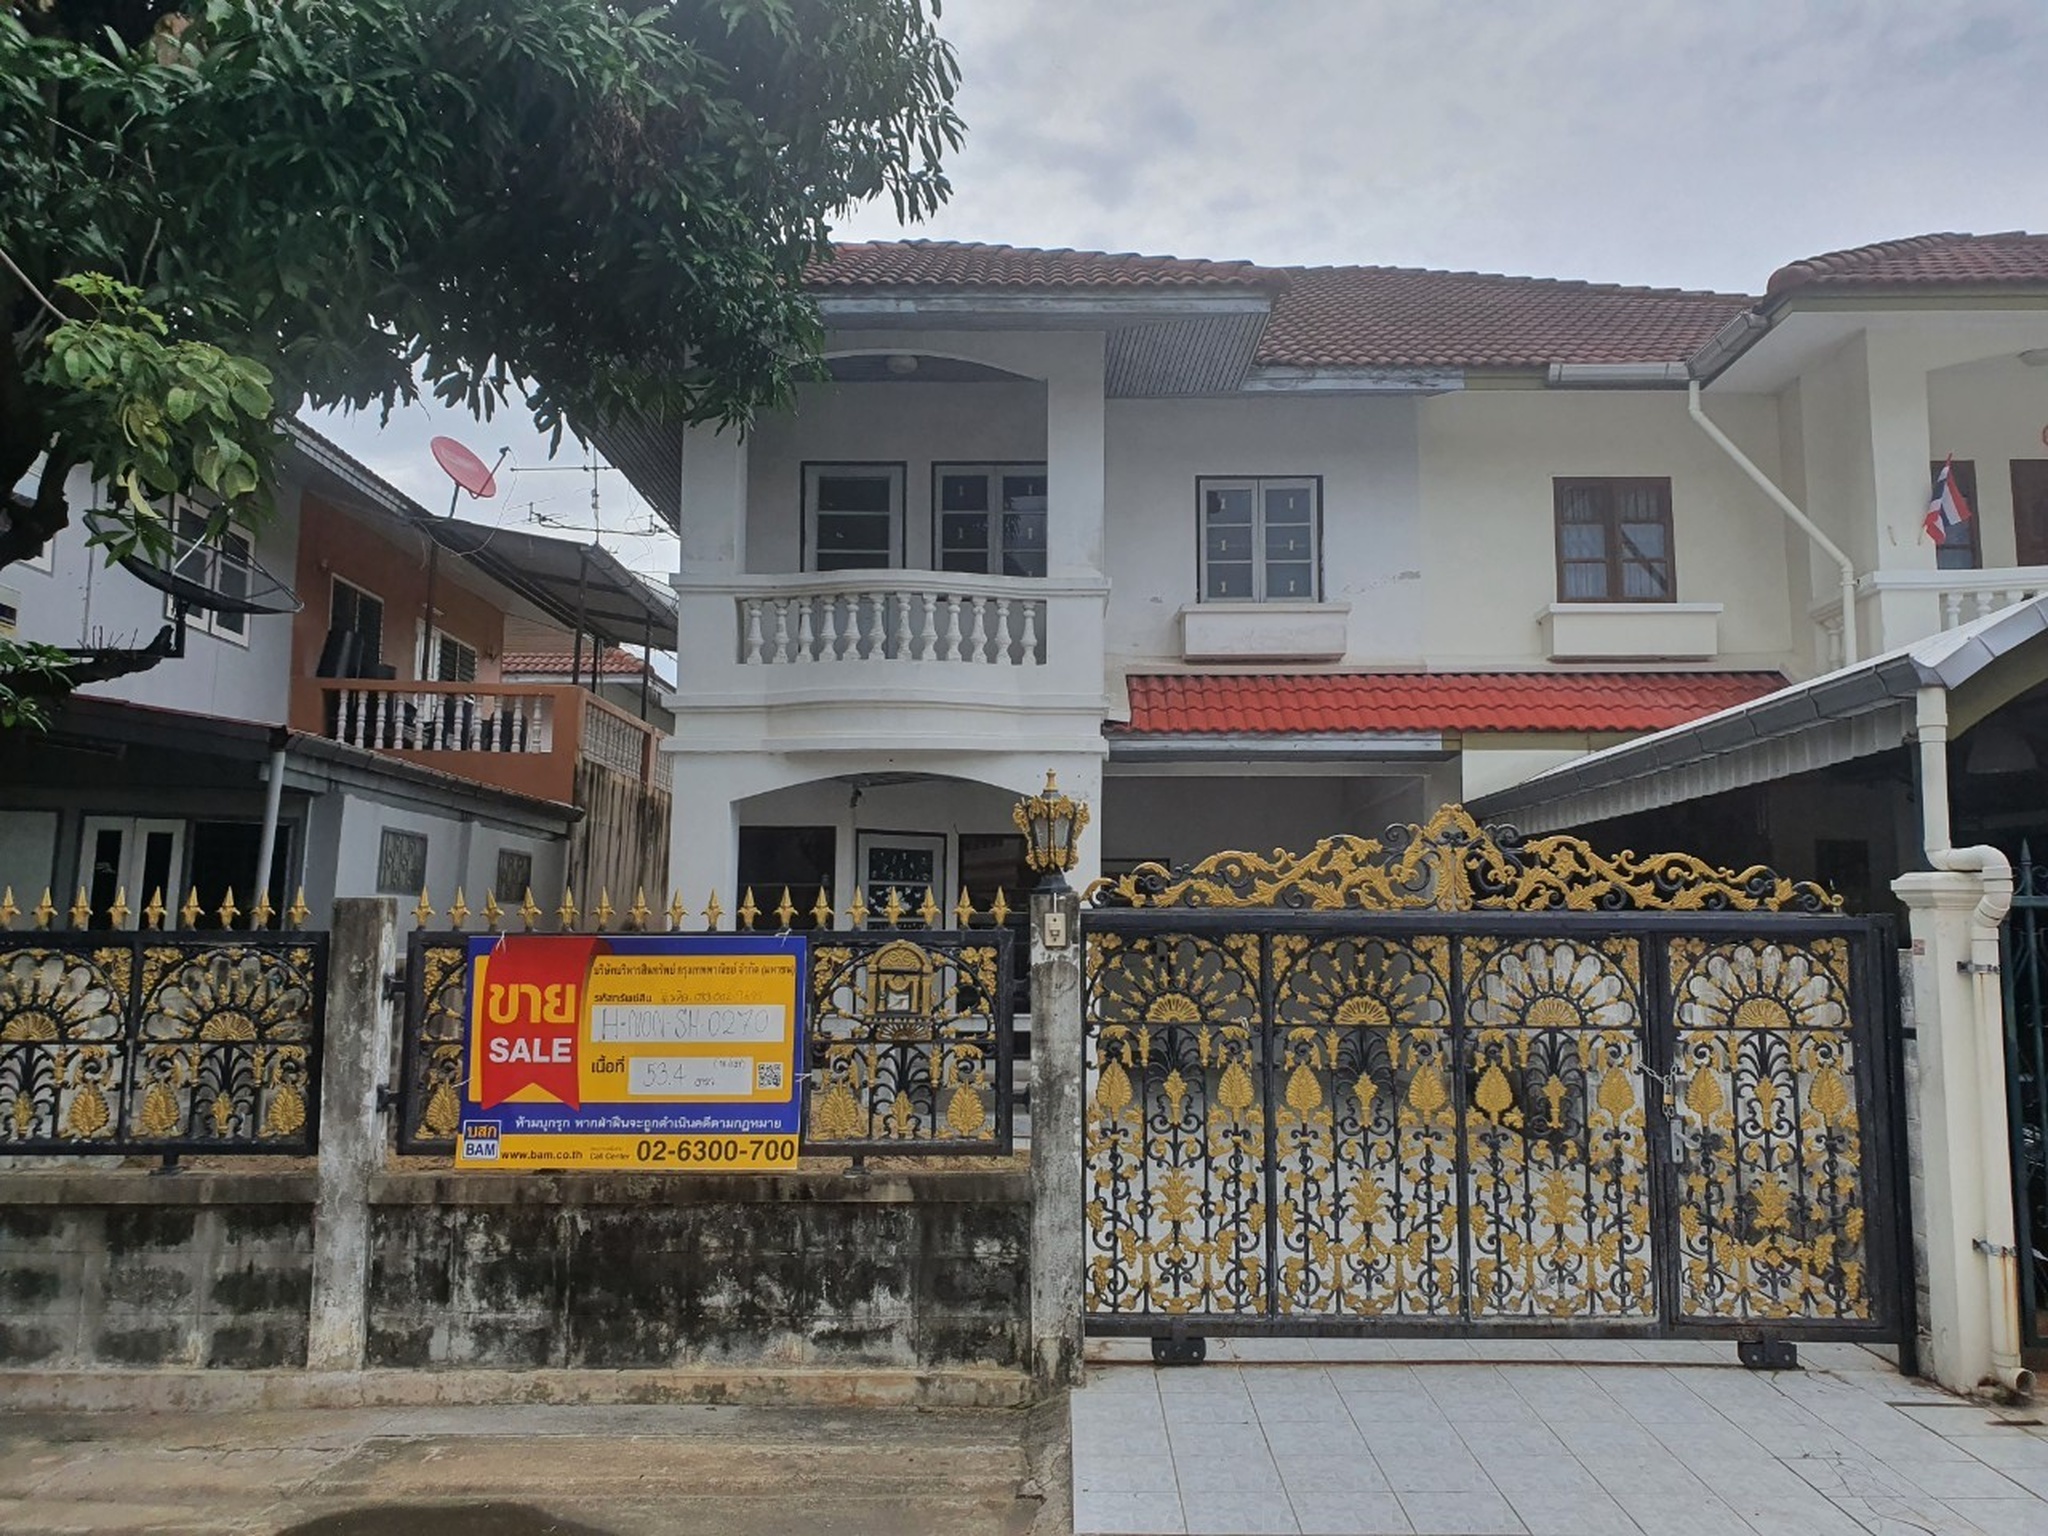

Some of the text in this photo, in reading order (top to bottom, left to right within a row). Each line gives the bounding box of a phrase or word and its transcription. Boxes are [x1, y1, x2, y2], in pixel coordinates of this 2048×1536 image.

[489, 983, 576, 1024] ขาย
[489, 1037, 572, 1063] SALE
[592, 1055, 625, 1074] เนื้อที่
[643, 1062, 686, 1087] 53.4
[466, 1125, 497, 1138] บสก
[516, 1116, 571, 1132] ห้ามบุกรุก
[466, 1142, 496, 1157] BAM
[501, 1150, 583, 1160] www.bam.co.th
[606, 1152, 630, 1161] Center
[636, 1139, 795, 1162] 02-6300-700
